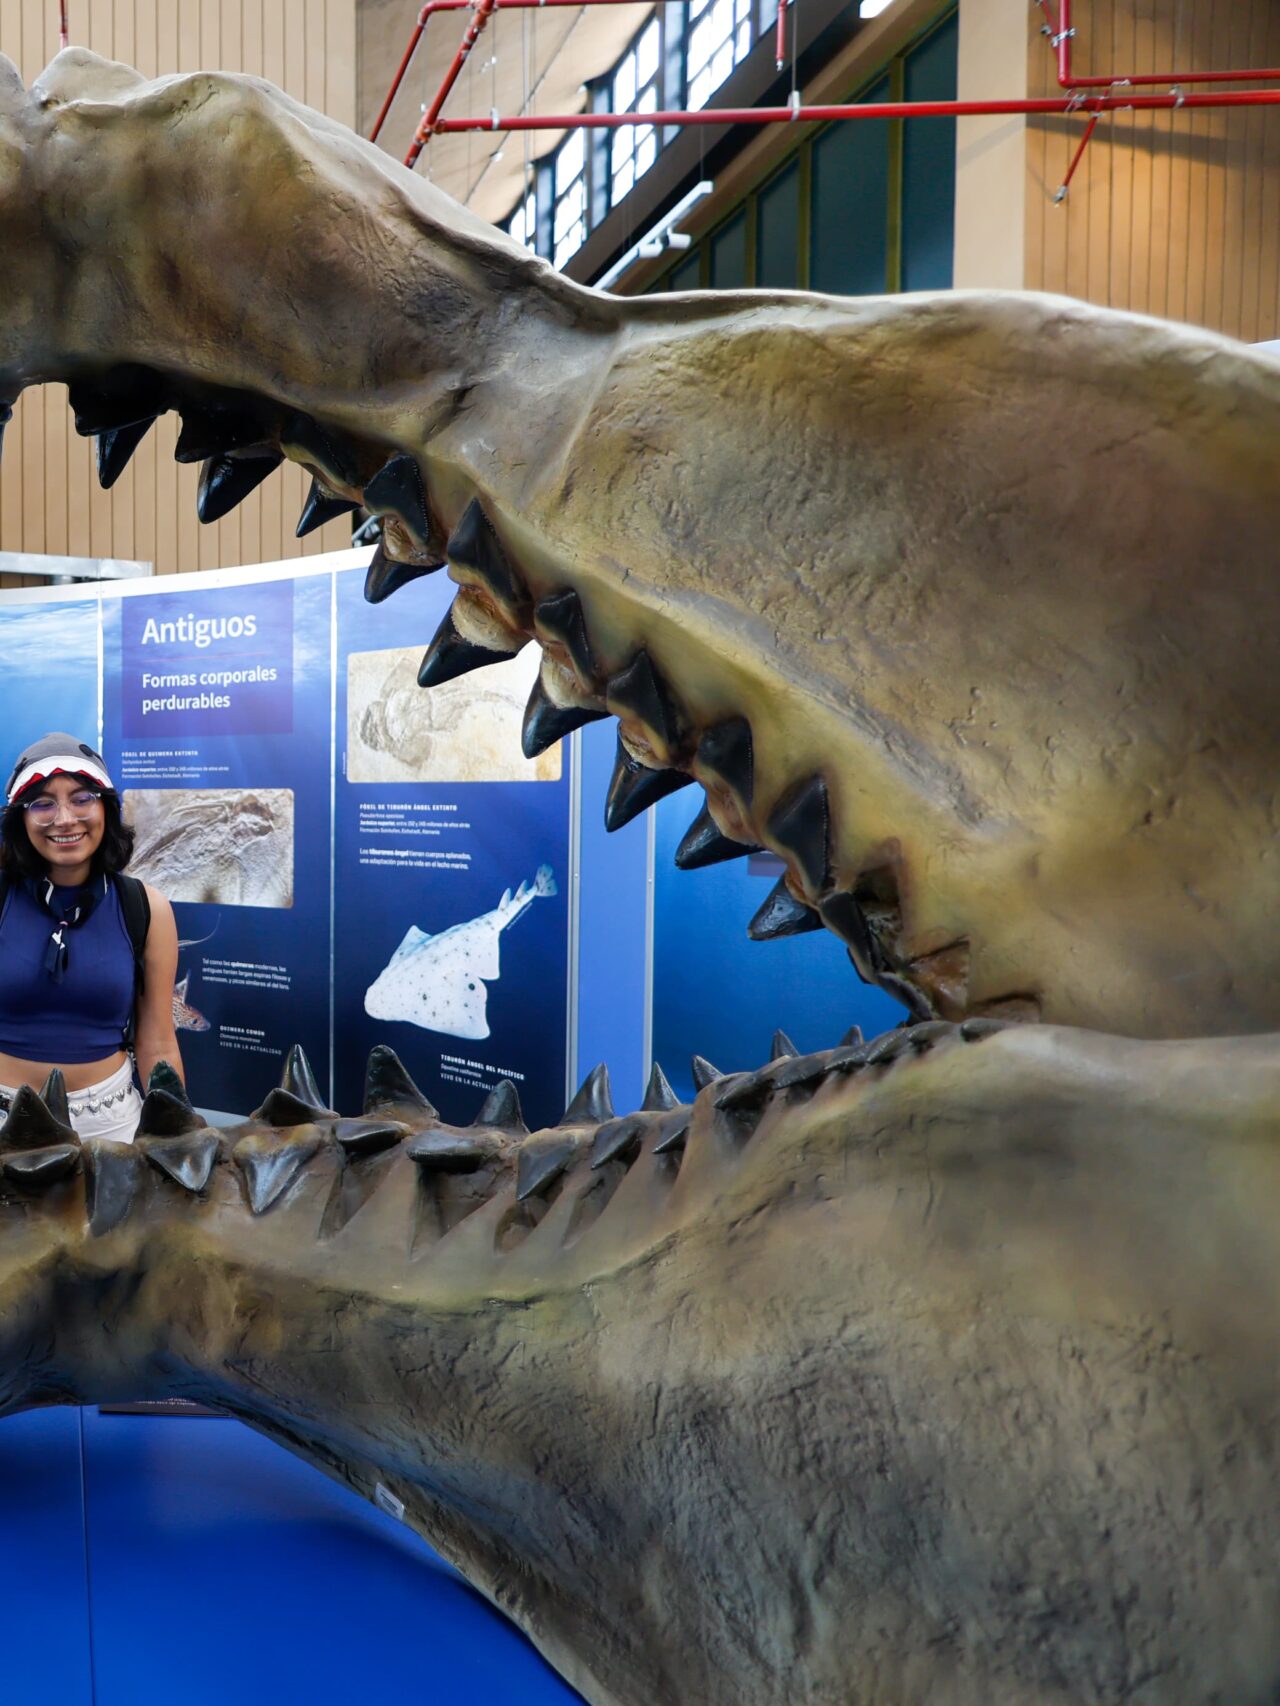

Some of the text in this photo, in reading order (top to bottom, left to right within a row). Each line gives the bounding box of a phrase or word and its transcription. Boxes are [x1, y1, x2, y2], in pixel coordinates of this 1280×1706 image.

[141, 613, 257, 648] Antiguos
[142, 665, 277, 688] Formas corporales
[142, 692, 231, 715] perdurables
